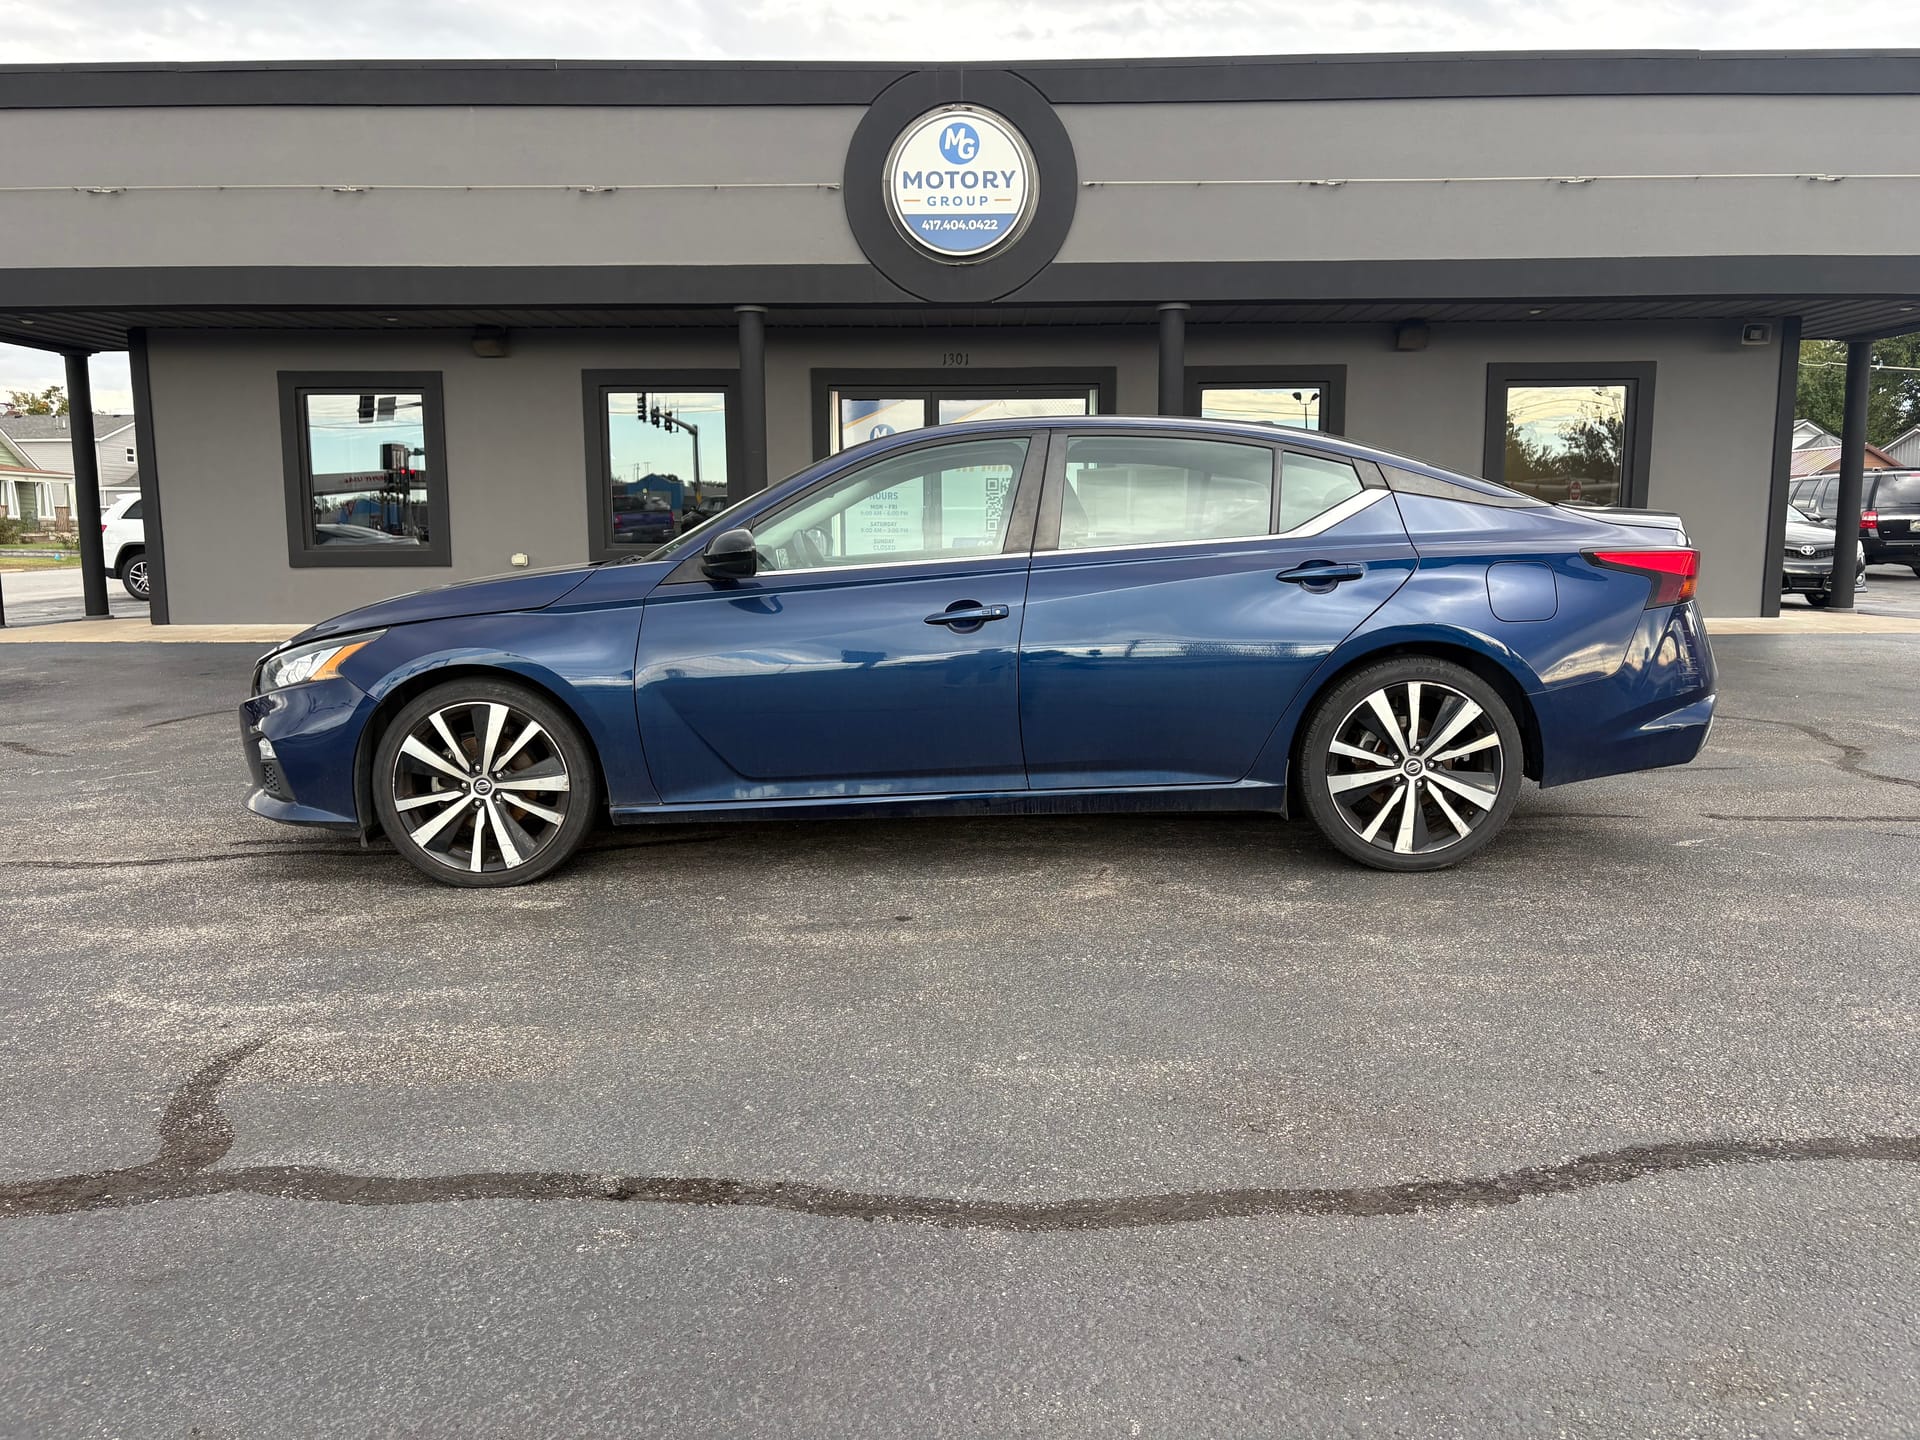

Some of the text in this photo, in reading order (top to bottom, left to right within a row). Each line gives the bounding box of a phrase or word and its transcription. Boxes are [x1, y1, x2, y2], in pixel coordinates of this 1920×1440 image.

[945, 127, 975, 160] MG
[902, 170, 1017, 189] MOTORY
[926, 195, 989, 207] GROUP
[921, 219, 998, 231] 417.404.0422
[943, 352, 968, 366] 1301
